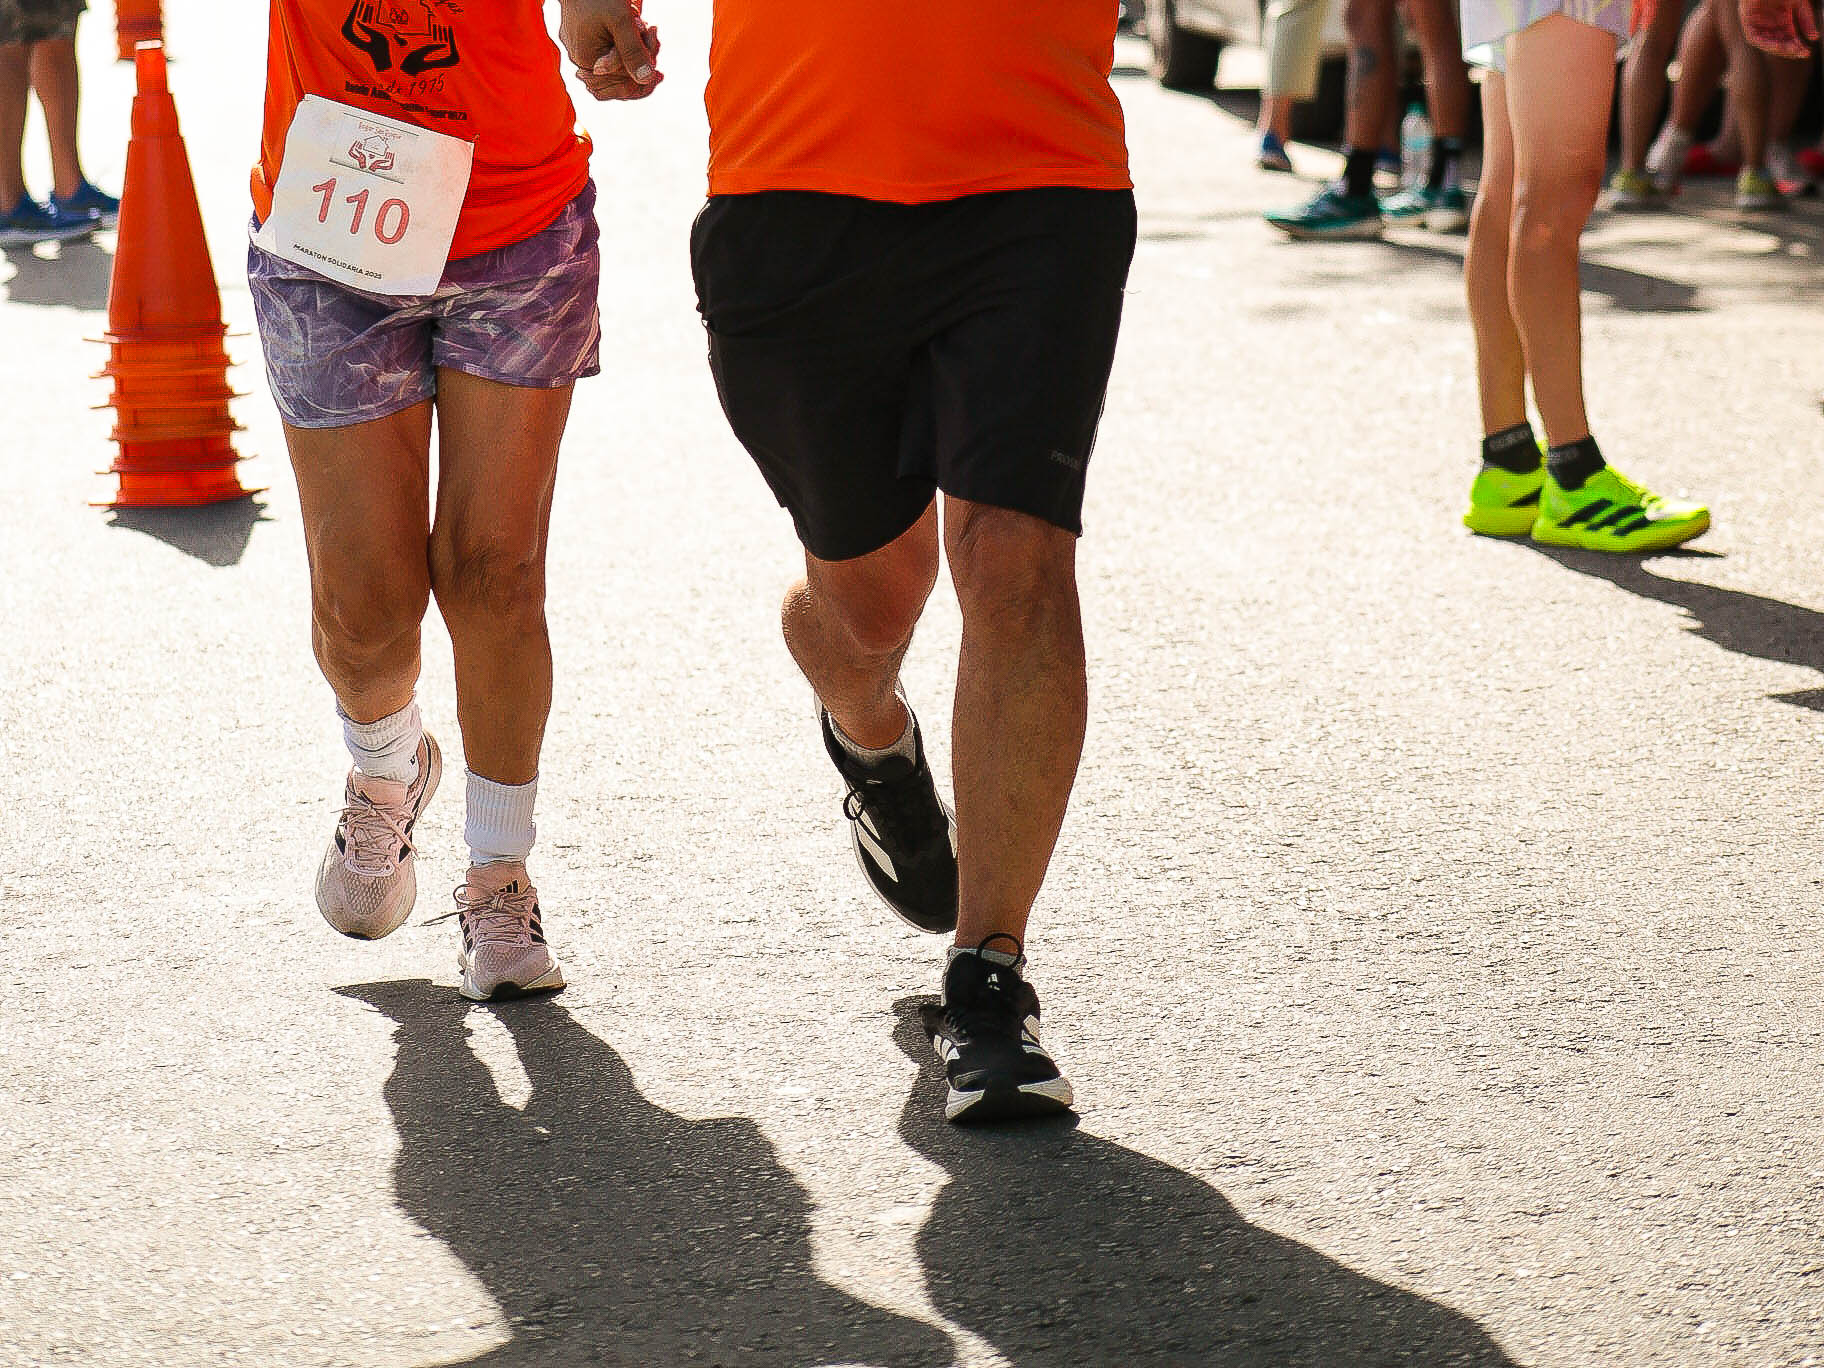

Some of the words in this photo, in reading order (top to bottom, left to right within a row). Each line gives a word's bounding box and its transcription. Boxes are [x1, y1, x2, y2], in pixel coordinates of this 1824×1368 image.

[312, 177, 411, 245] 110
[293, 243, 328, 262] MARATON
[327, 257, 364, 275] SOLIDARIA
